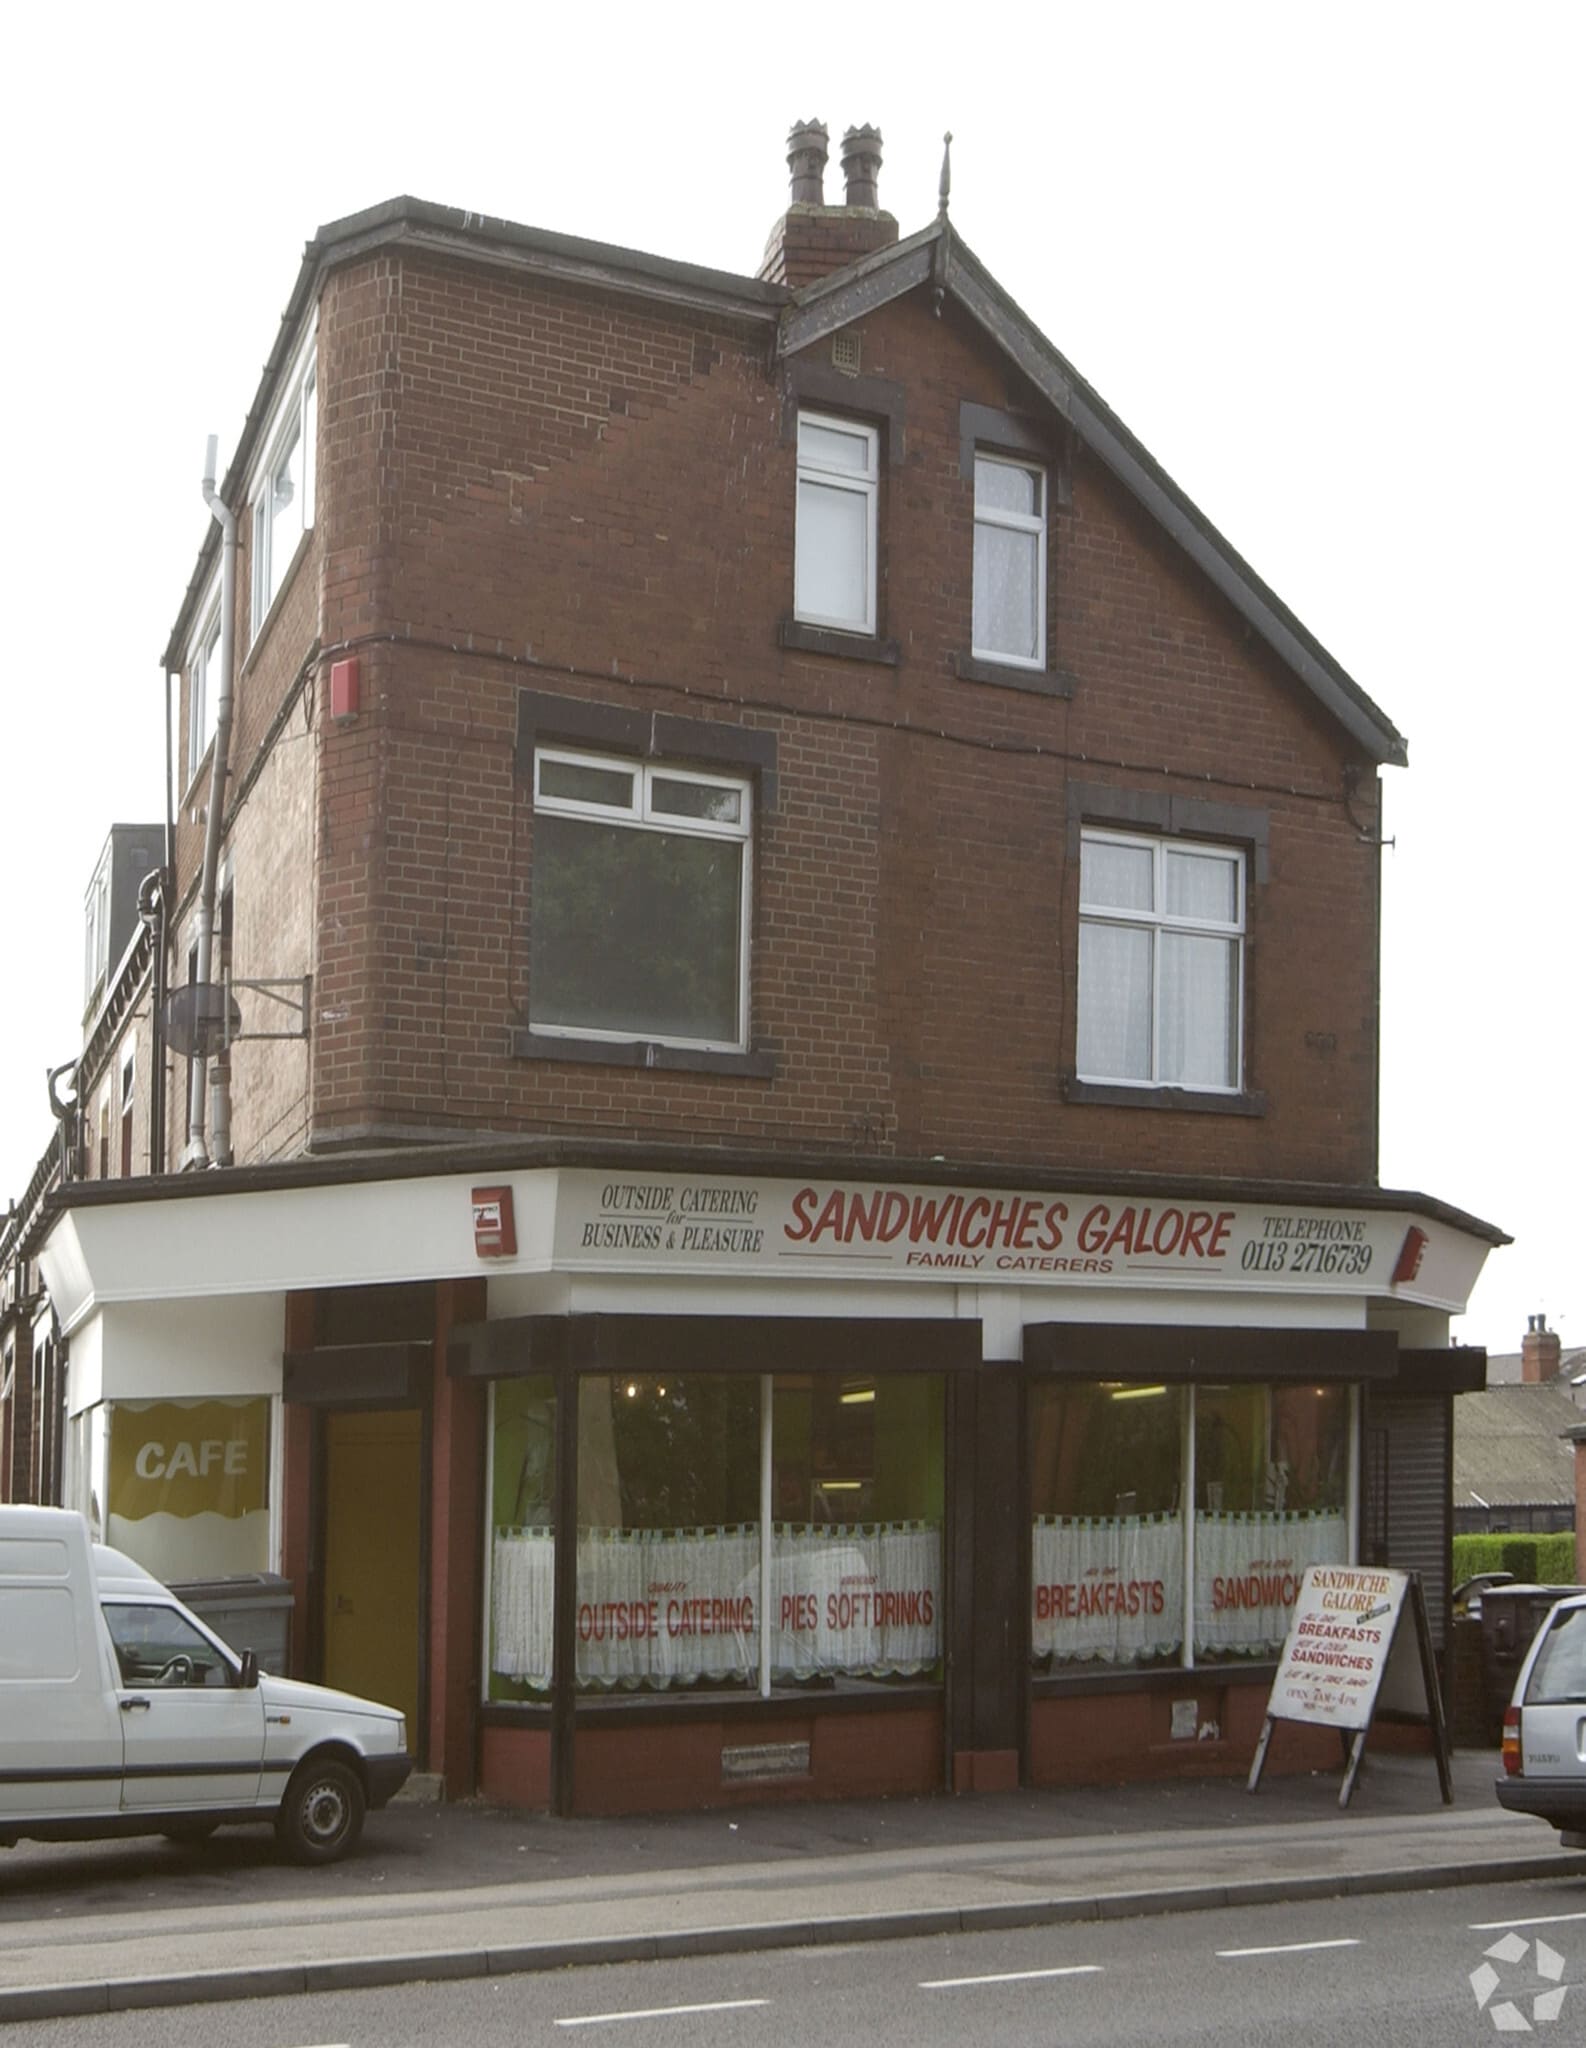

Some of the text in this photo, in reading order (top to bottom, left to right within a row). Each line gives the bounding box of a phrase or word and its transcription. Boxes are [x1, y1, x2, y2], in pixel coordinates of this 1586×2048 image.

[601, 1184, 759, 1215] OUTSIDE CATERING
[664, 1209, 686, 1226] for
[783, 1186, 1236, 1257] SANDWICHES GALORE
[1262, 1216, 1367, 1241] TELEPHONE
[581, 1223, 764, 1253] BUSINESS & PLEASURE
[906, 1251, 1113, 1273] FAMILY CATERERS
[1241, 1241, 1373, 1275] 0113 2716739
[135, 1439, 249, 1480] CAFE
[781, 1589, 934, 1631] PIES SOFT DRINKS
[1035, 1580, 1165, 1620] BREAKFASTS
[1322, 1591, 1376, 1612] GALORE
[578, 1596, 753, 1642] OUTSIDE CATERING
[1298, 1622, 1381, 1644] BREAKFASTS
[1290, 1649, 1374, 1671] SANDWICHES
